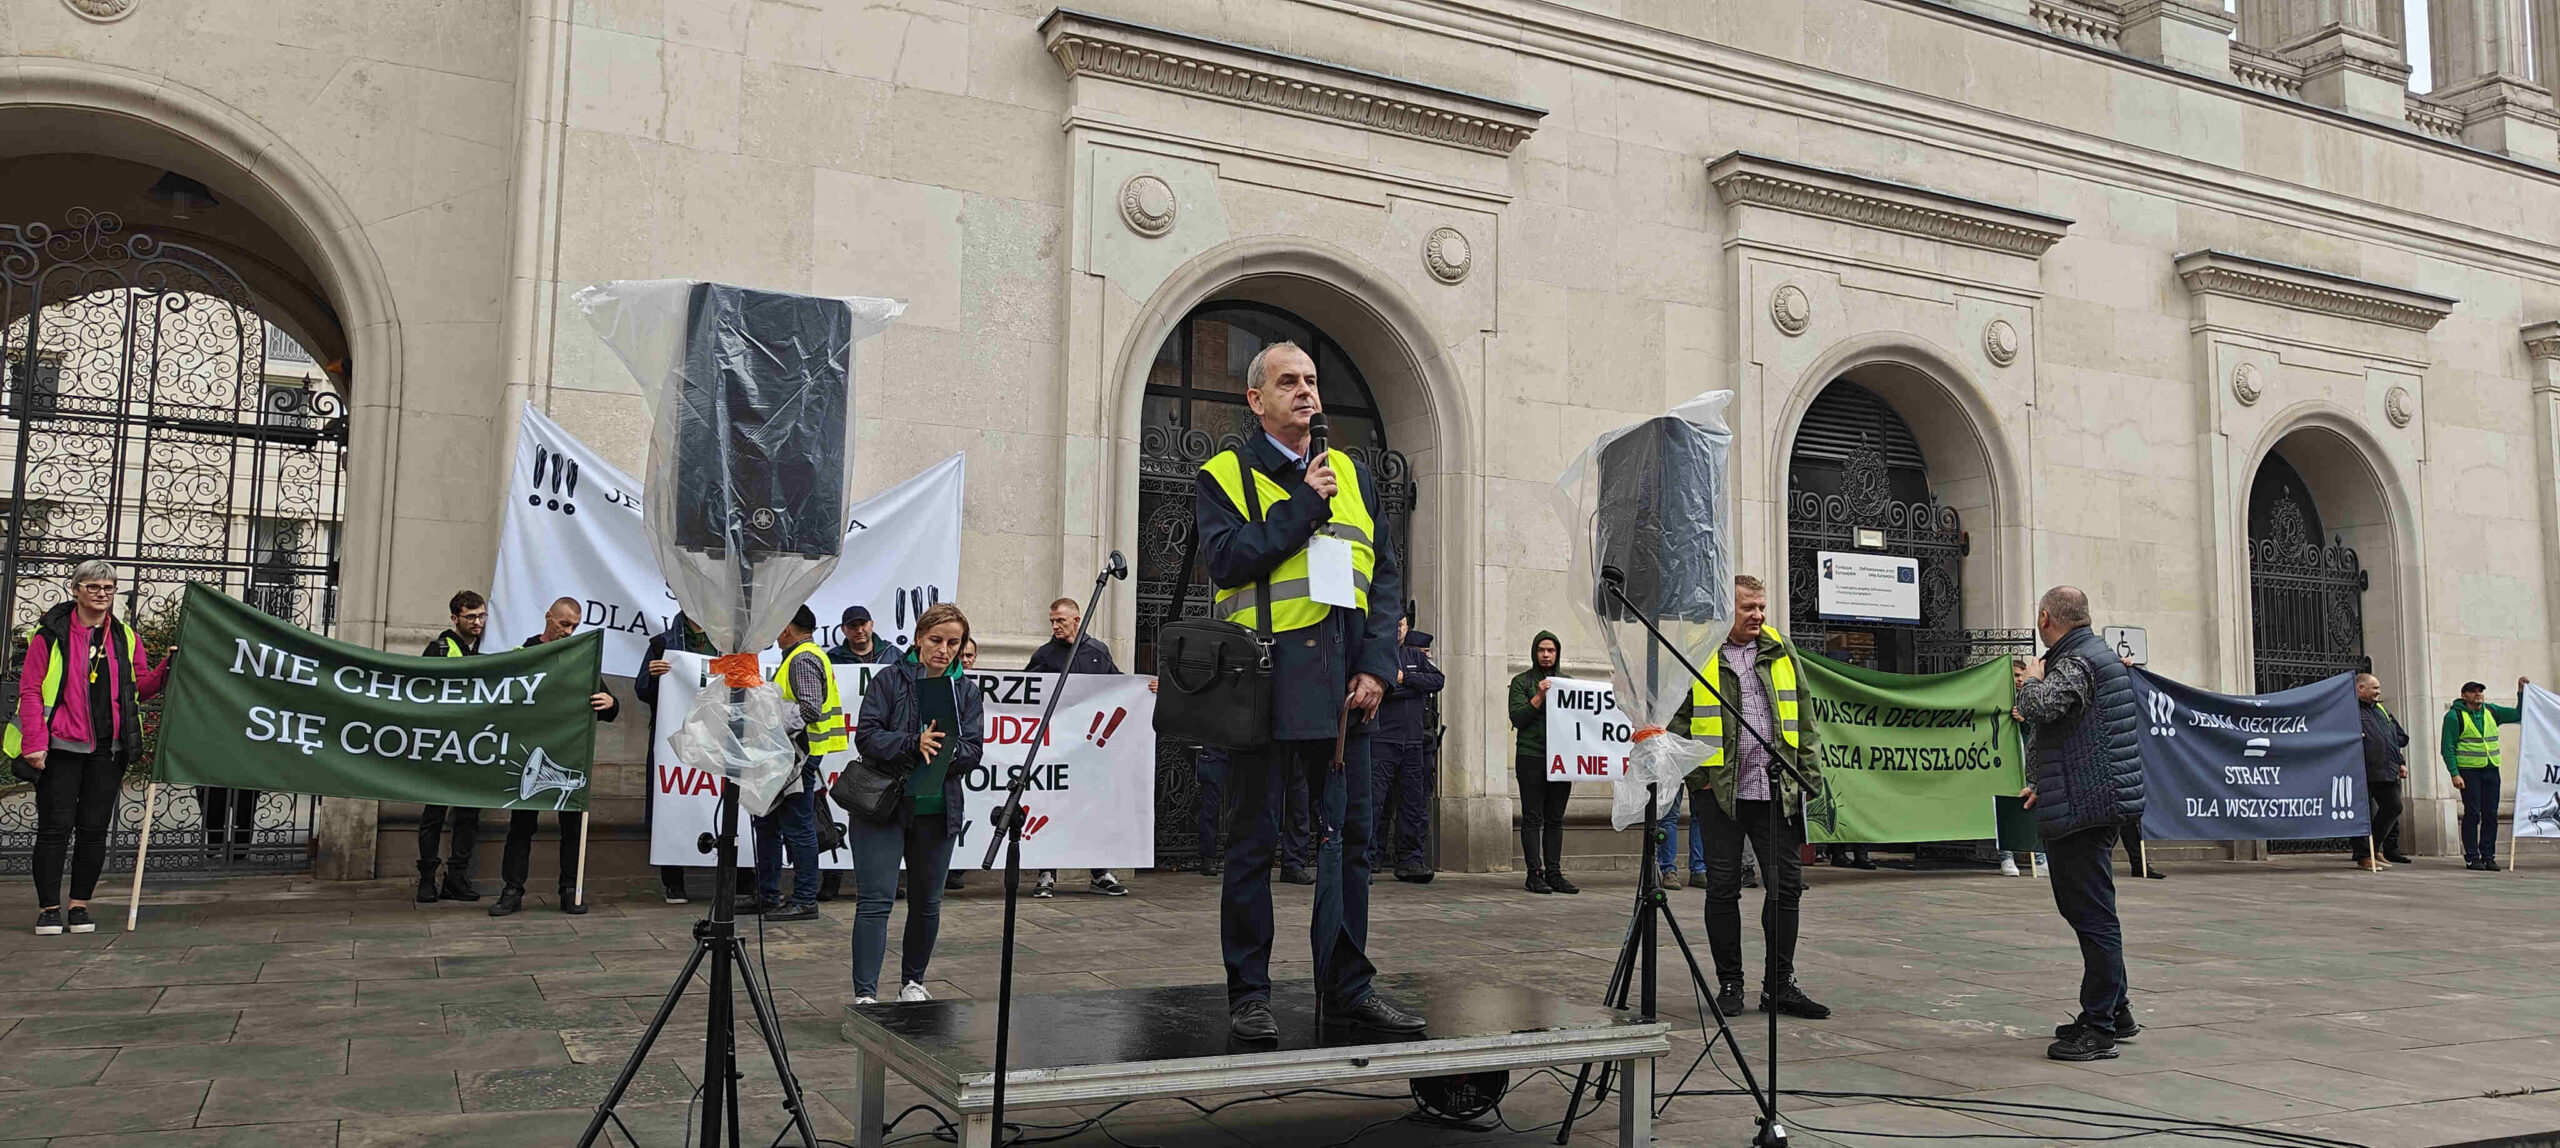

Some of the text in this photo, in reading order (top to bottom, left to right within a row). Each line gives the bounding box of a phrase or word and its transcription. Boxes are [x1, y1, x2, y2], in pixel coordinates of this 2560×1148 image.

[605, 488, 641, 512] JE
[583, 600, 650, 636] DLA
[229, 637, 548, 705] NIE CHCEMY
[966, 674, 1043, 705] RZE
[1557, 689, 1616, 715] MIEJS
[1811, 696, 1976, 733] WASZA DECYZJA,
[2238, 715, 2309, 734] DECYZJA
[245, 705, 510, 766] SIĘ COFAĆ!
[984, 715, 1051, 746] UDZI
[1602, 722, 1632, 743] RO
[1550, 754, 1567, 775] A
[1577, 755, 1608, 776] NIE
[1820, 742, 1863, 770] ASZA
[658, 765, 728, 797] WA
[964, 764, 1069, 792] OLSKIE
[2224, 765, 2281, 785] STRATY
[2186, 797, 2220, 817] DLA
[2225, 797, 2324, 818] WSZYSTKICH
